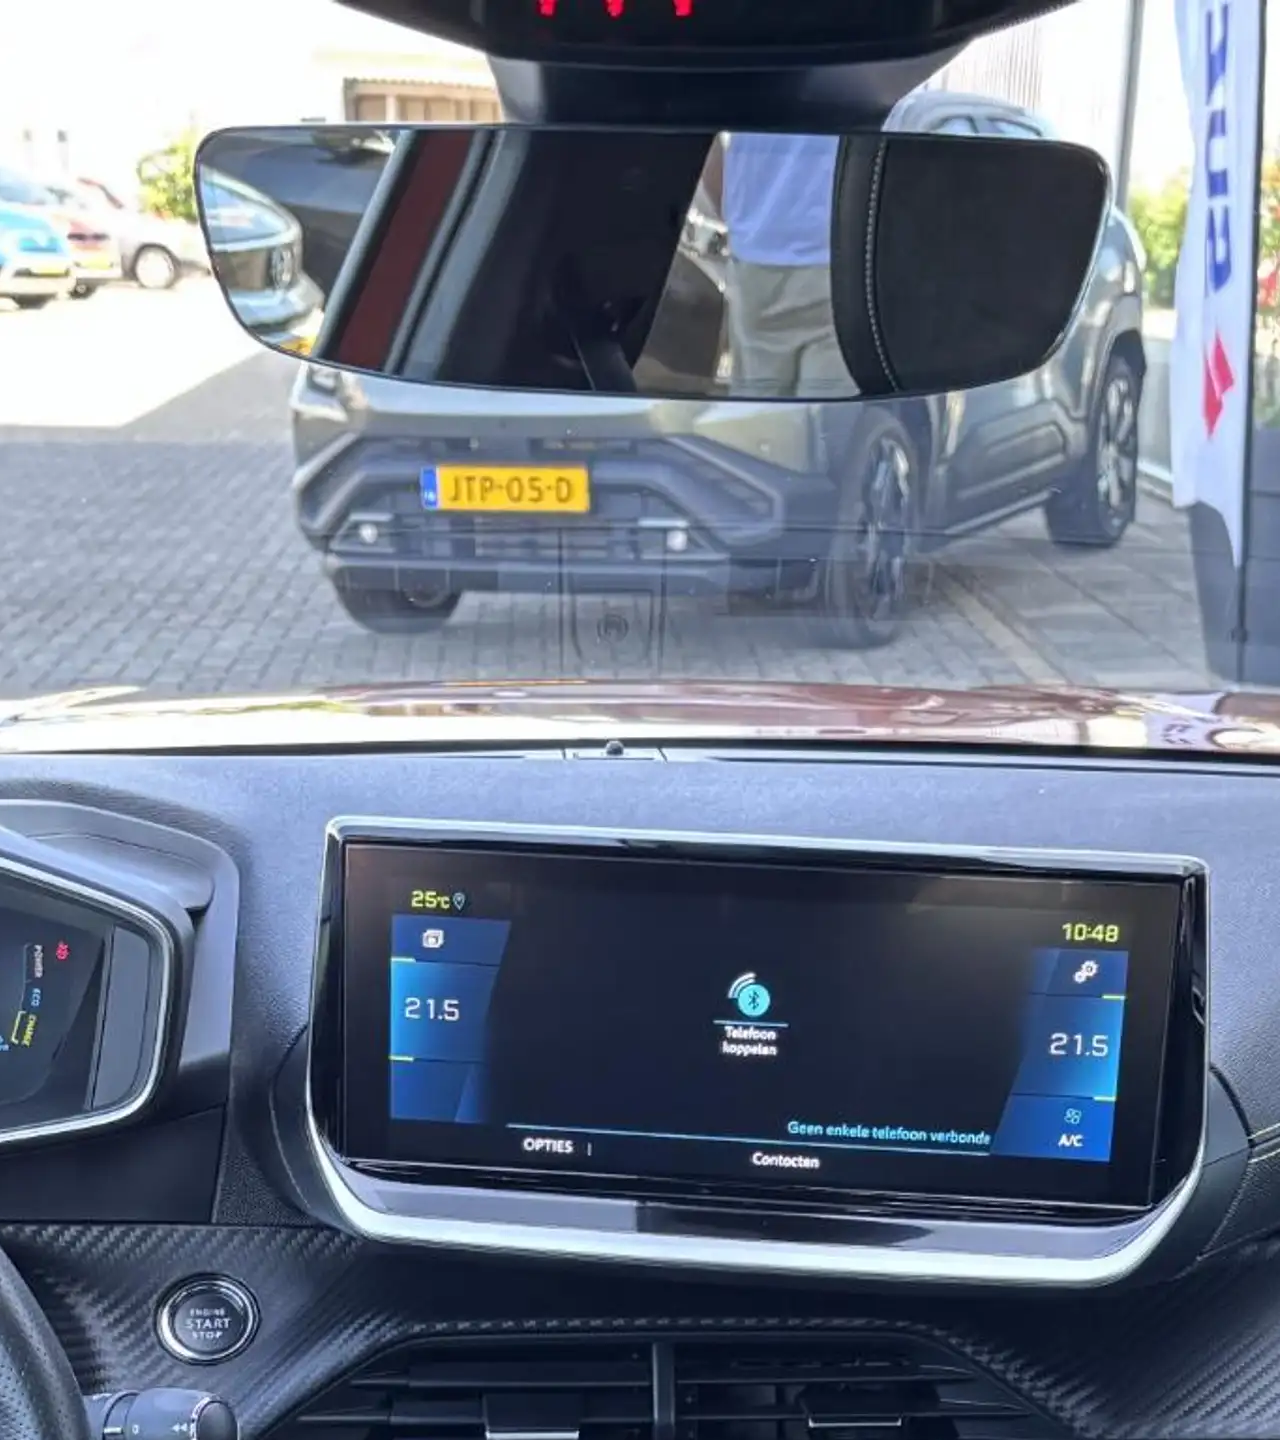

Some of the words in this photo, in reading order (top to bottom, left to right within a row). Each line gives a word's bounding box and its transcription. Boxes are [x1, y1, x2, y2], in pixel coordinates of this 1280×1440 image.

[1061, 922, 1120, 943] 10:48
[404, 997, 460, 1022] 21.5
[724, 1026, 777, 1041] Telefoon
[722, 1041, 778, 1057] koppelen
[1048, 1032, 1109, 1057] 21.5
[787, 1120, 824, 1136] Geen
[826, 1123, 870, 1139] enkele
[871, 1126, 927, 1141] telefoon
[523, 1138, 574, 1154] OPTIES
[1058, 1134, 1083, 1148] A/C
[185, 1317, 232, 1329] START
[191, 1330, 224, 1340] STOP
